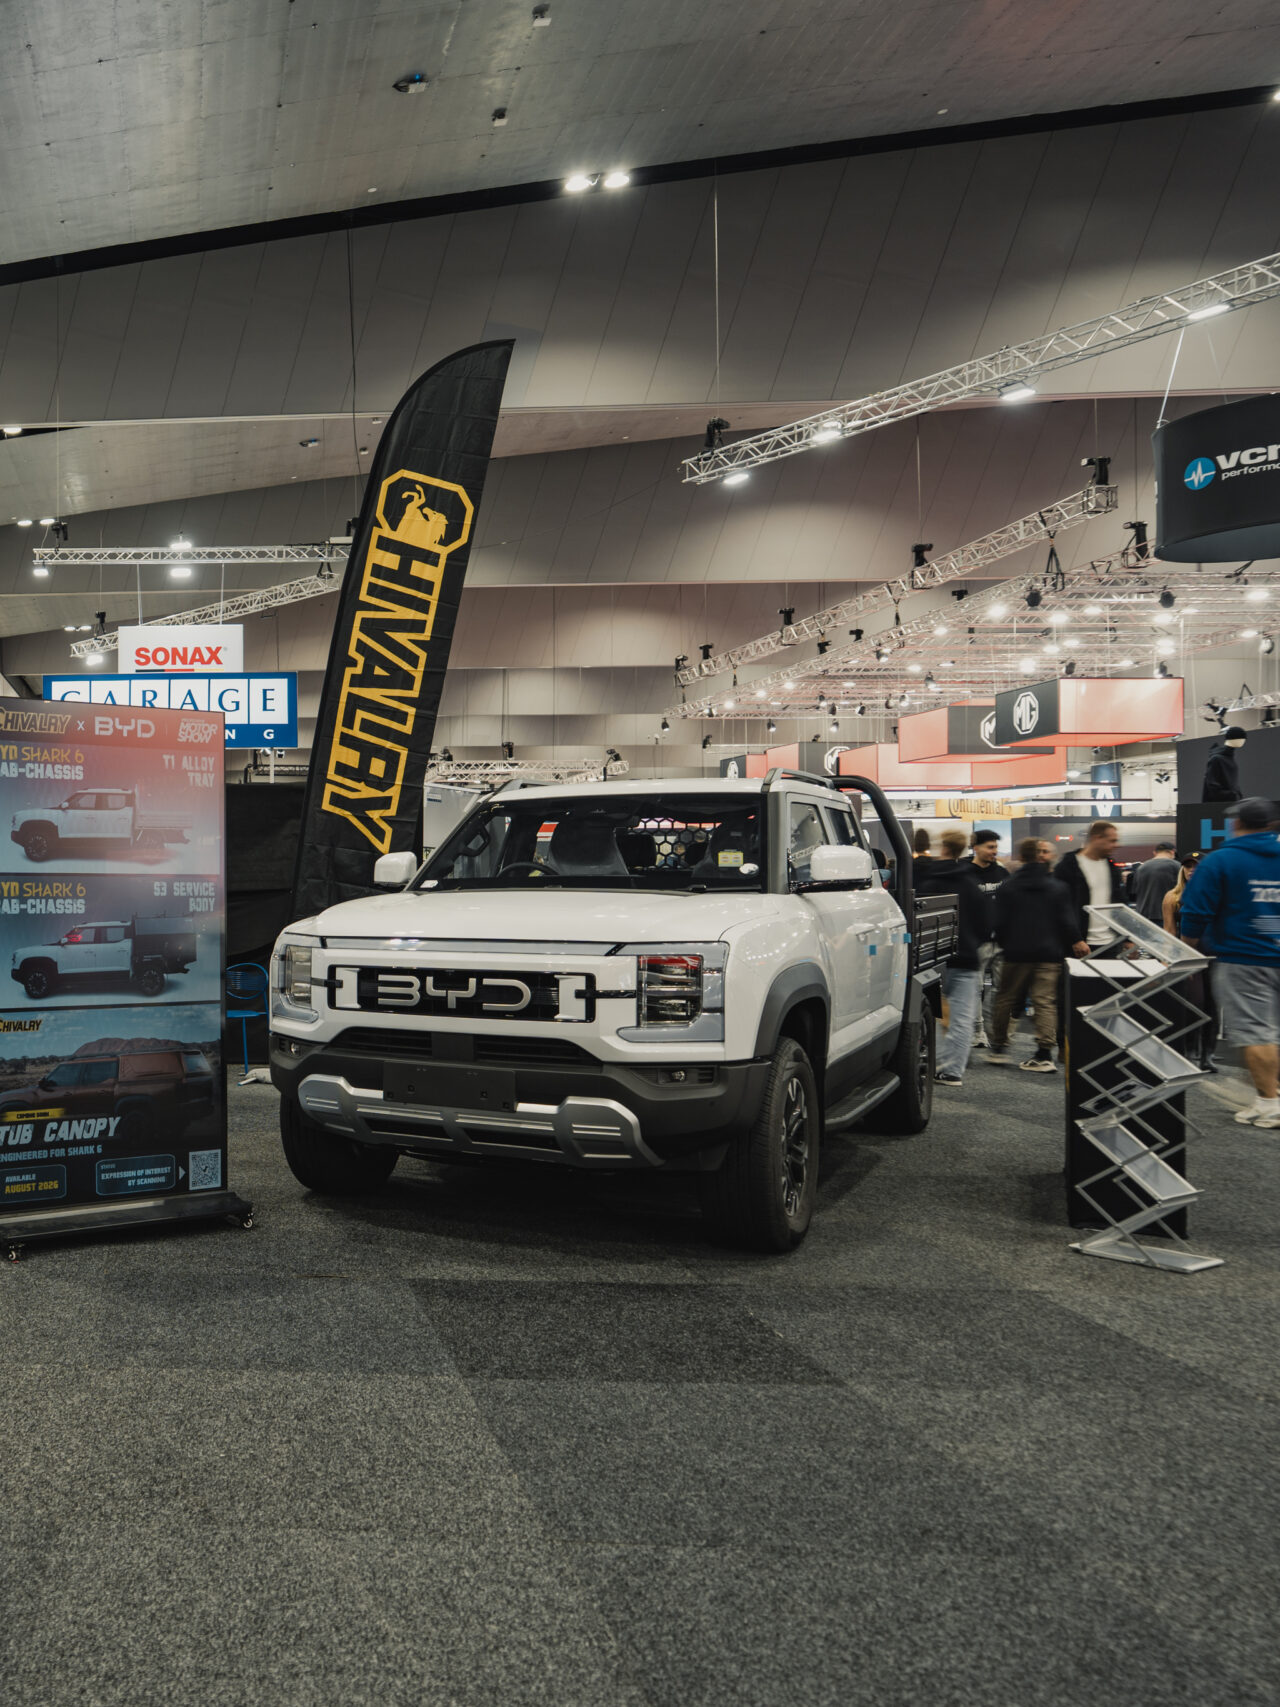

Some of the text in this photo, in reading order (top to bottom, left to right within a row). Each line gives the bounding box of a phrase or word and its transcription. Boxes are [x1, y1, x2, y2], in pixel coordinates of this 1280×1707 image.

[134, 646, 223, 667] SONAX
[321, 468, 475, 855] CHIVALRY
[94, 716, 155, 739] BYD
[180, 722, 218, 735] MOTOR
[177, 731, 212, 744] SHOW
[21, 747, 71, 763] SHARK
[74, 749, 85, 764] 6
[162, 754, 215, 772] T1 ALLOY
[187, 771, 215, 788] TRAY
[23, 882, 71, 897] SHARK
[76, 882, 86, 897] 6
[153, 881, 216, 897] S3 SERVICE
[189, 897, 216, 912] BODY
[377, 973, 532, 1012] BYD
[43, 1116, 122, 1142] CANOPY
[49, 1148, 66, 1158] FOR
[67, 1145, 95, 1156] SHARK
[96, 1144, 103, 1154] 6
[5, 1173, 36, 1183] AVAILABLE
[101, 1166, 172, 1180] EXPRESSION OF INTEREST
[4, 1180, 59, 1195] AUGUST 2026
[127, 1175, 166, 1187] BY SCANNING
